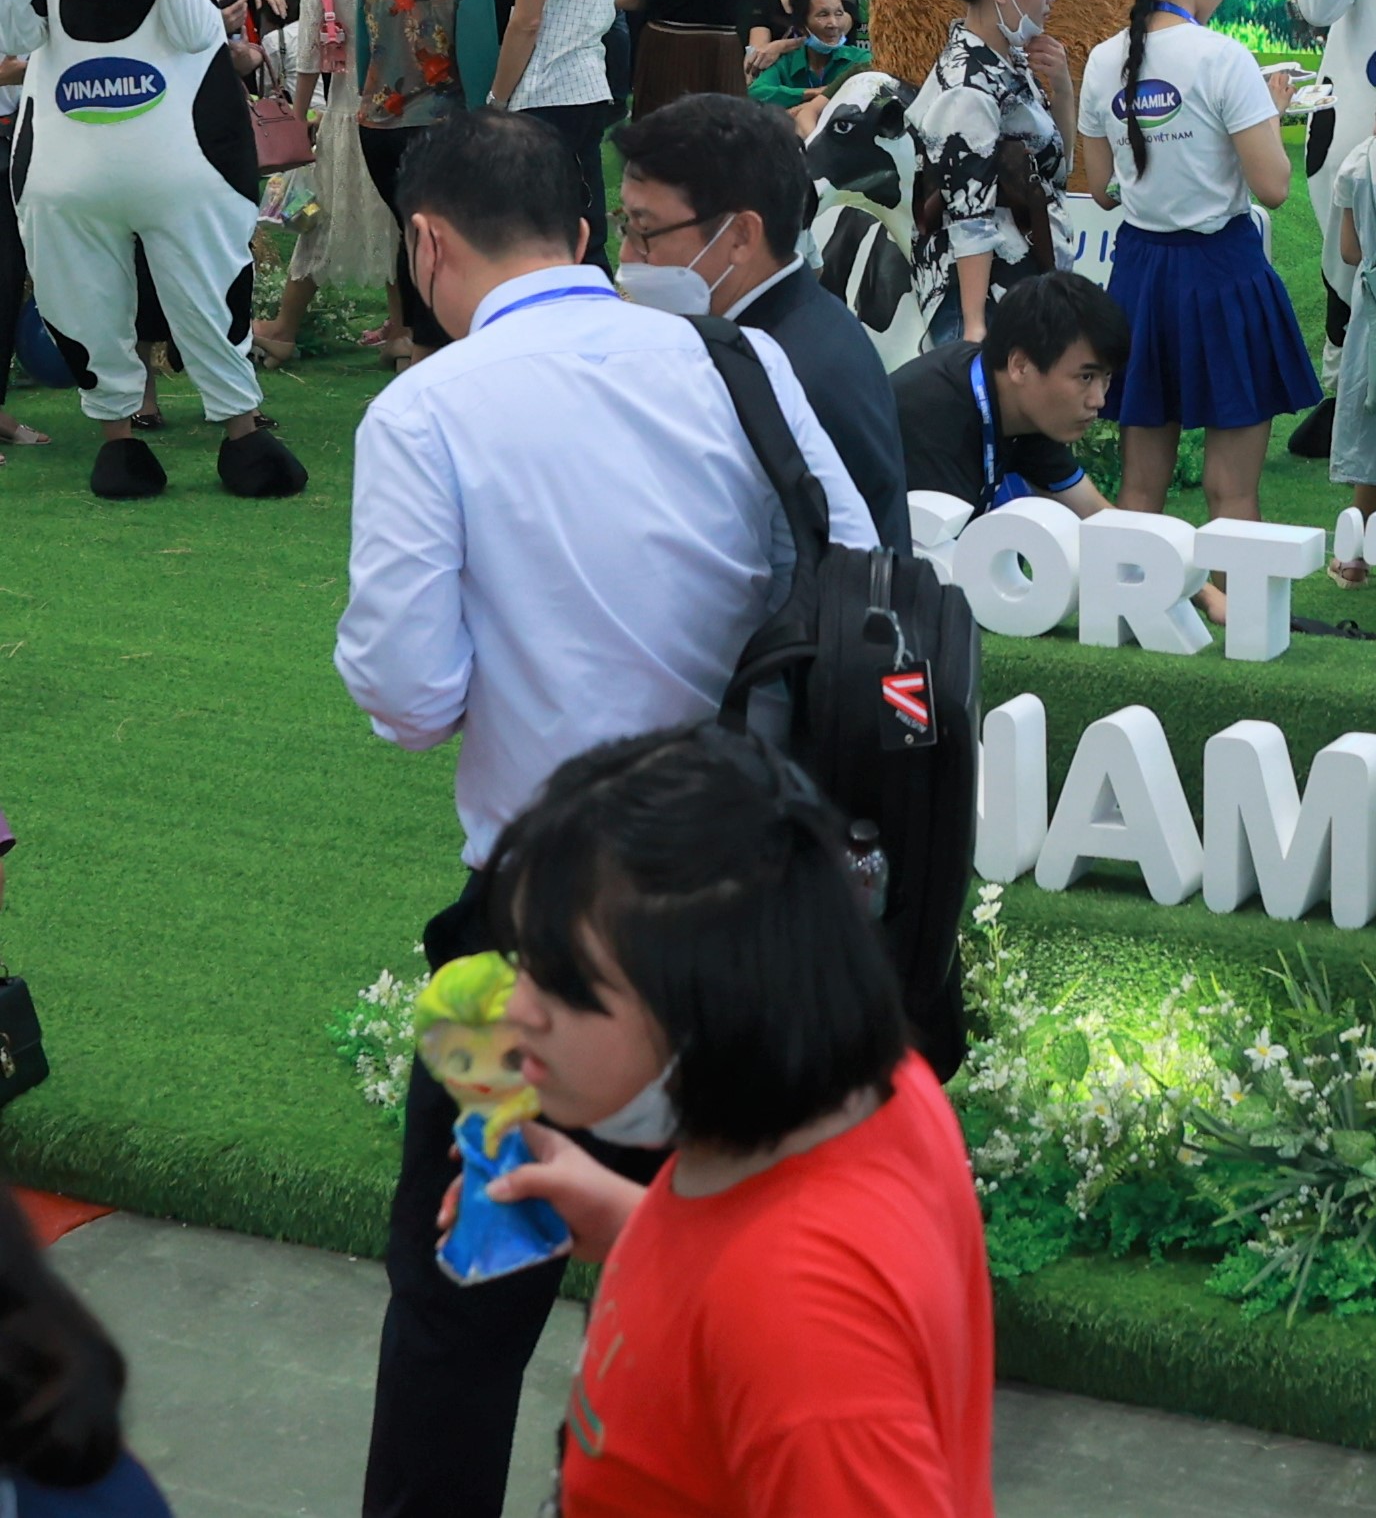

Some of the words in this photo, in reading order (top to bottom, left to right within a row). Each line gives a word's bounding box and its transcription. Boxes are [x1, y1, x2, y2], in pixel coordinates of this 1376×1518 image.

[62, 74, 157, 101] VINAMILK
[1118, 91, 1176, 112] VNAMILK
[1171, 130, 1194, 141] NAM
